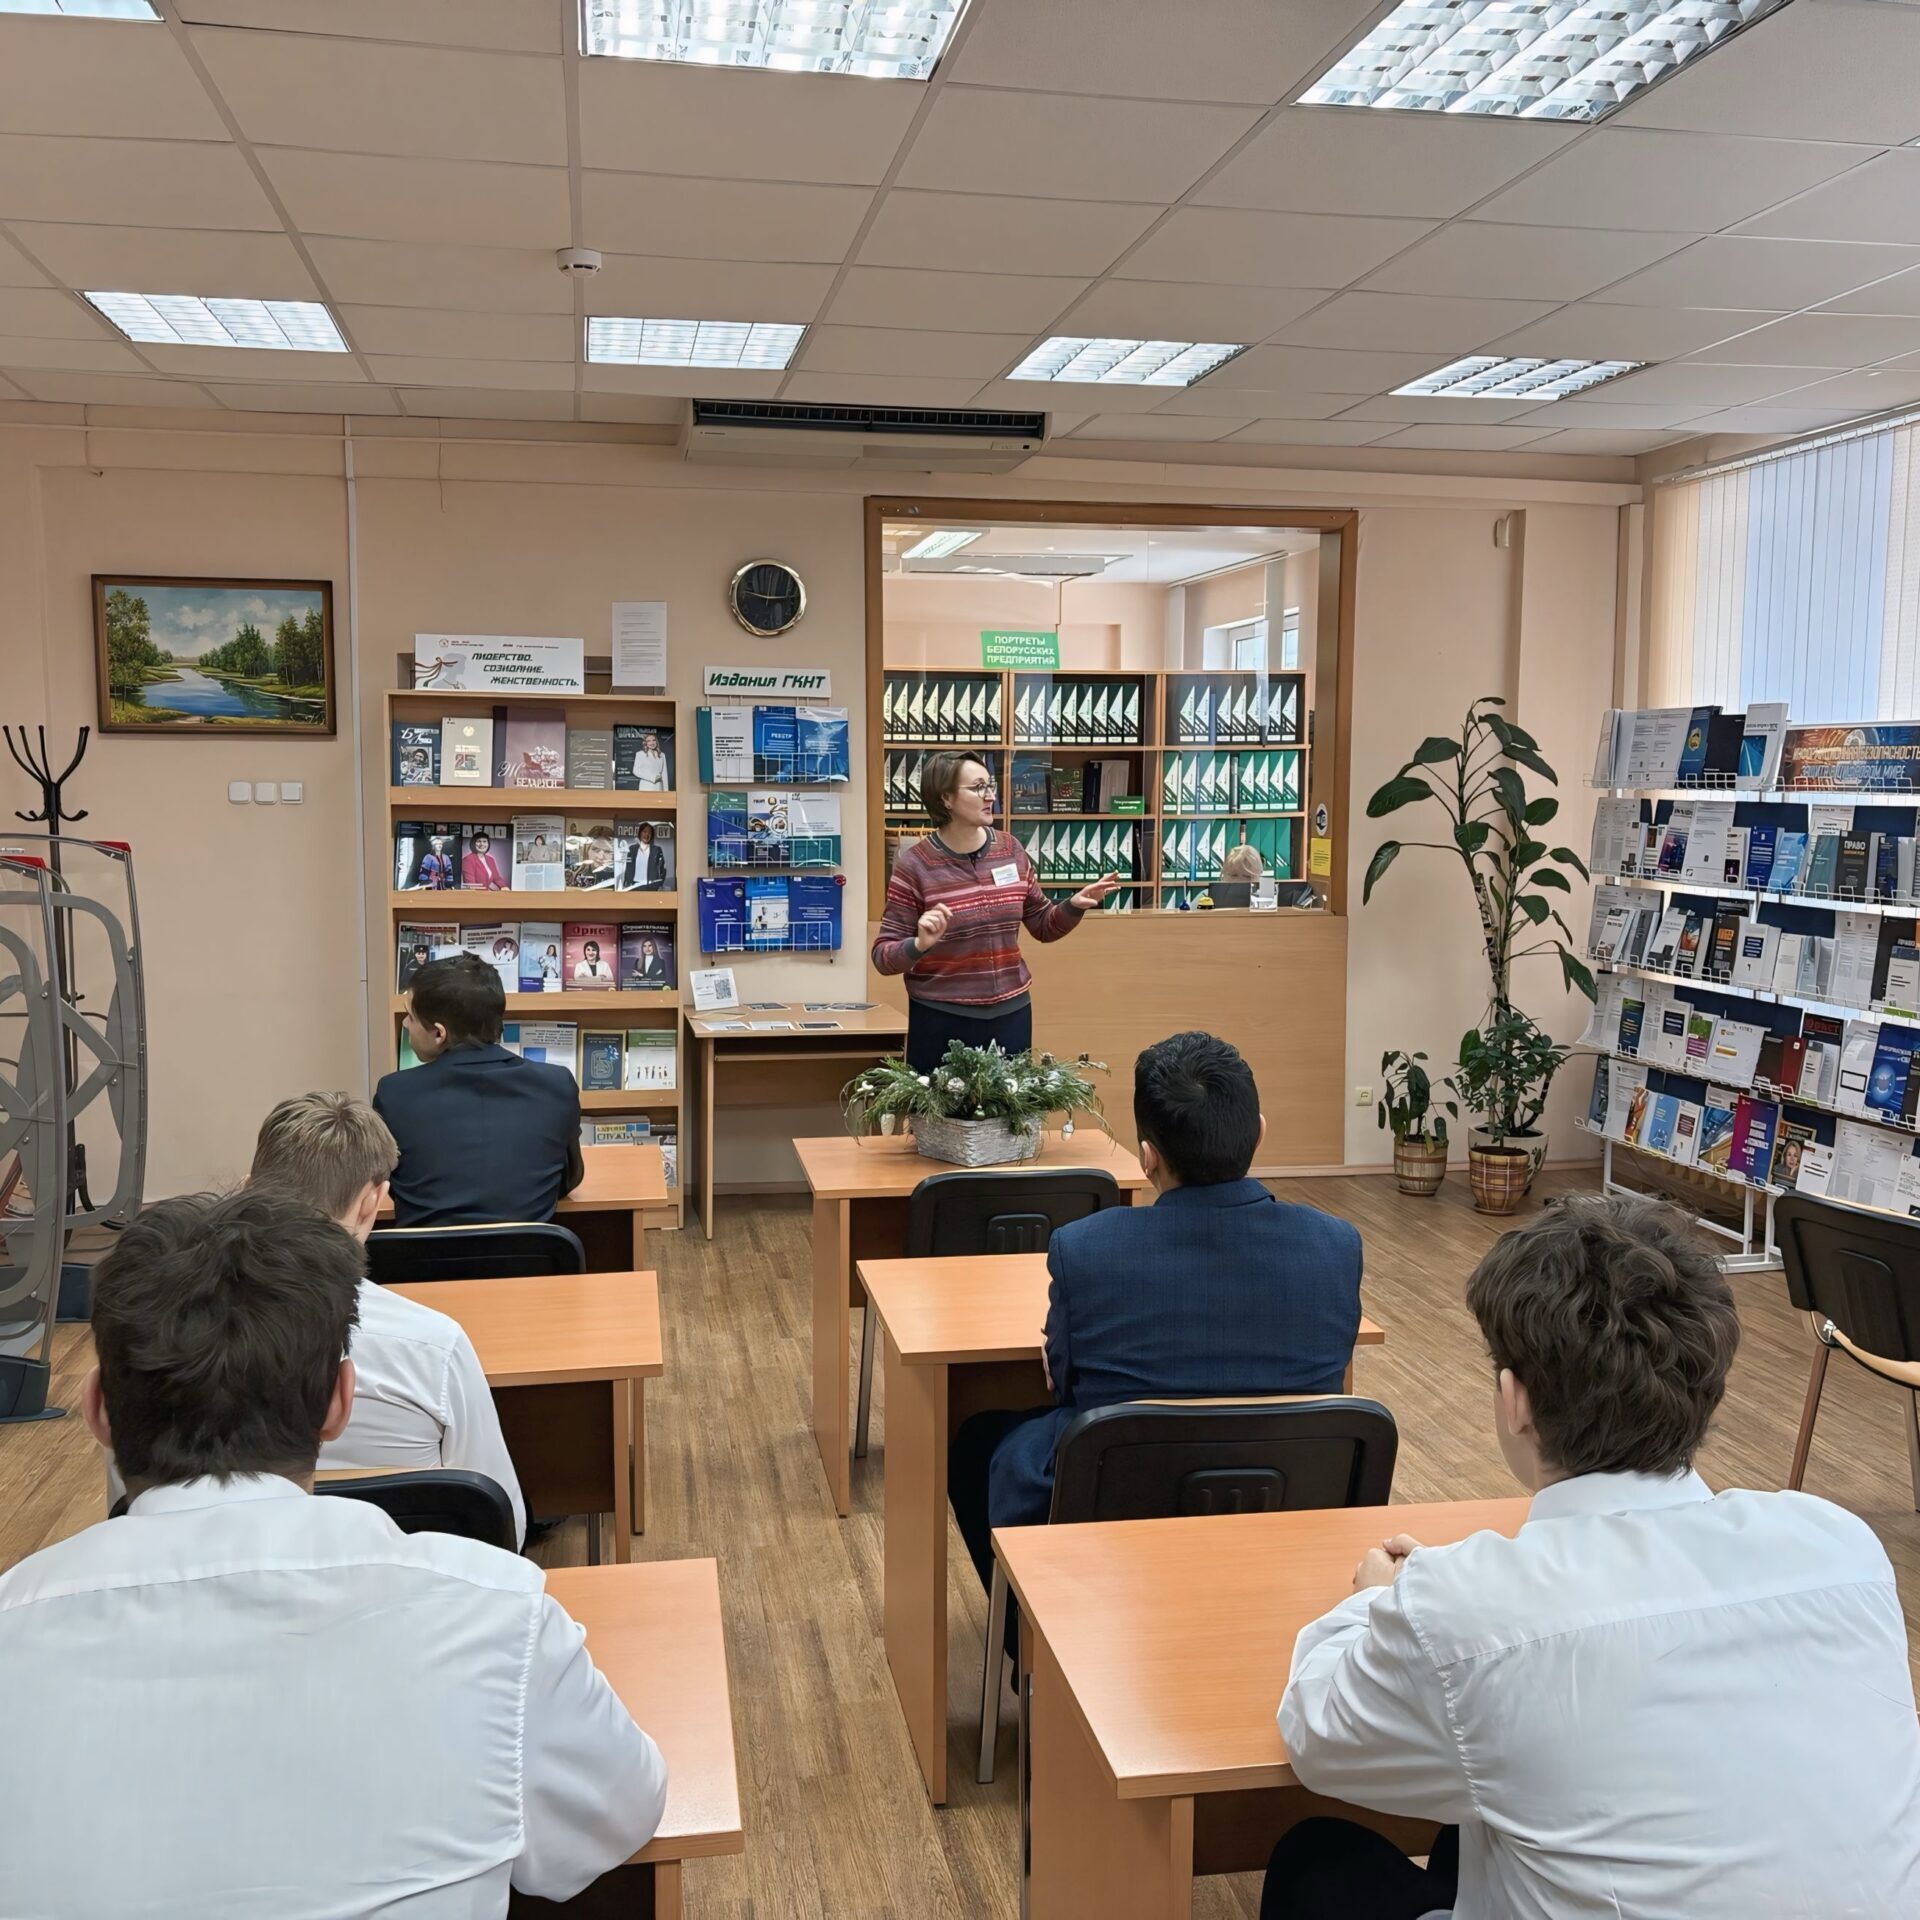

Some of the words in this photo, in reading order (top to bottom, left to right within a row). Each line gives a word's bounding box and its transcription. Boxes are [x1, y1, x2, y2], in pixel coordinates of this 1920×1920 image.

[995, 635, 1046, 645] ПОРТРЕТЫ
[987, 645, 1055, 655] БЕЛОРУССКИХ
[472, 653, 533, 662] ЛИДЕРСТВО.
[987, 655, 1055, 665] ПРЕДПРИЯТИЙ
[483, 664, 545, 674] СОЗИДАНИЕ.
[490, 676, 580, 687] ЖЕНСТВЕННОСТЬ.
[709, 673, 778, 688] Издания
[782, 675, 826, 688] ГКНТ
